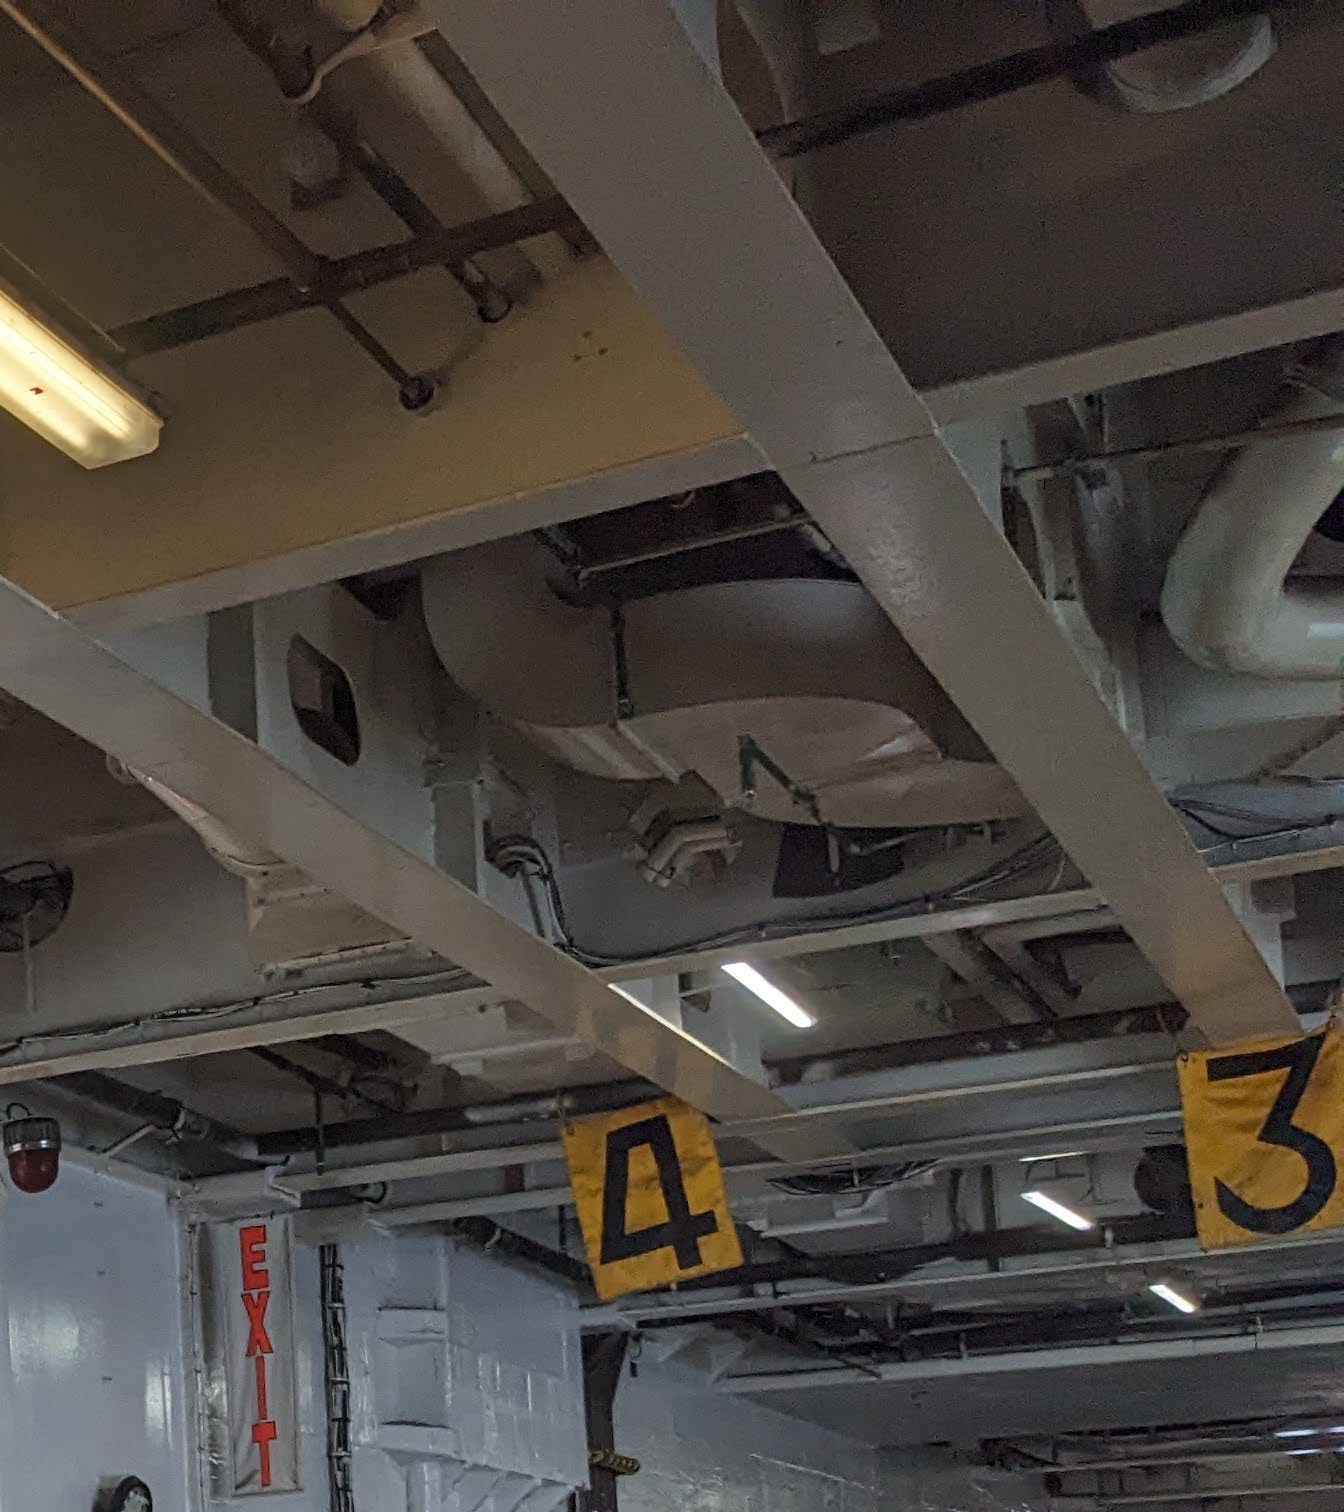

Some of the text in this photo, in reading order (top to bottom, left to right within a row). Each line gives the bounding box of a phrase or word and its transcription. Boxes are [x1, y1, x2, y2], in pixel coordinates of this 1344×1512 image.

[599, 1114, 719, 1271] 4
[1206, 1031, 1337, 1234] 3
[239, 1224, 277, 1487] EXIT
